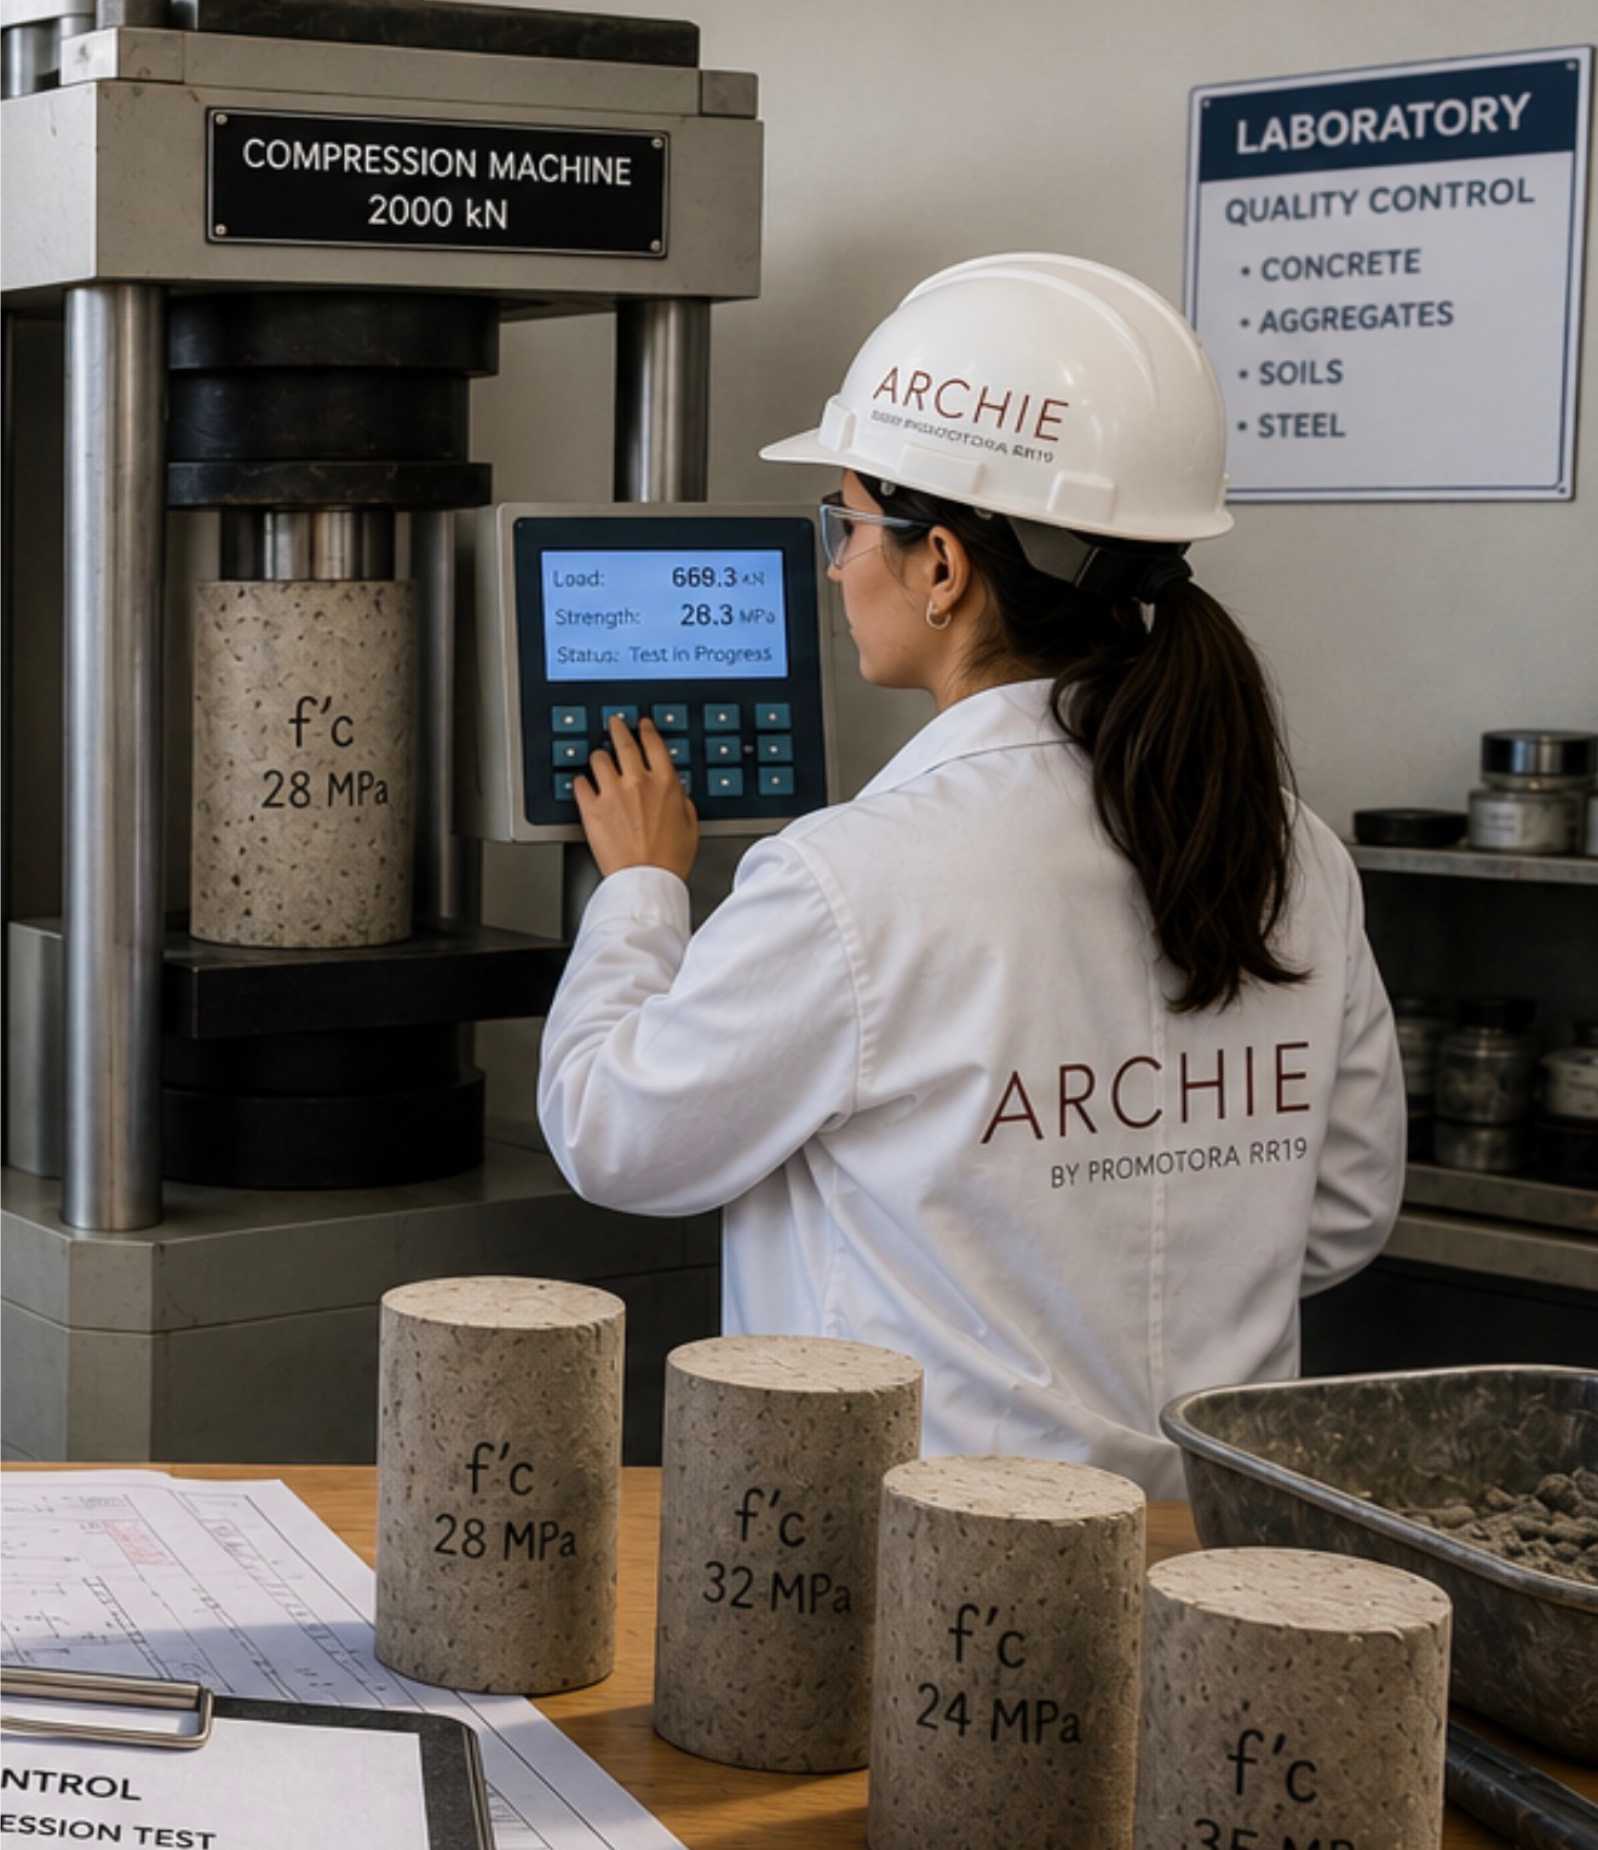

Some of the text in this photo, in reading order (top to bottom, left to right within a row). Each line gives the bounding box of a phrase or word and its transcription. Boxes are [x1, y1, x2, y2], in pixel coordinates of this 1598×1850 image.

[1236, 92, 1532, 155] LABORATORY
[242, 138, 632, 187] COMPRESSION MACHINE
[368, 195, 508, 230] 2000 kN
[1225, 178, 1535, 226] QUALITY CONTROL
[1261, 249, 1421, 282] CONCRETE
[1258, 301, 1454, 335] AGGREGATES
[1258, 359, 1343, 386] SOILS
[872, 366, 1069, 443] ARCHIE
[1257, 413, 1346, 439] STEEL
[553, 570, 604, 588] Load:
[555, 608, 640, 629] Strength:
[630, 646, 668, 662] Test
[672, 646, 690, 661] in
[694, 646, 772, 665] Progress
[261, 769, 388, 809] 28 MPa
[979, 1041, 1311, 1144] ARCHIE
[1050, 1137, 1308, 1189] BY PROMOTORA RR19
[434, 1513, 577, 1562] 28 MPa
[702, 1561, 851, 1615] 32 MPa
[915, 1682, 1082, 1745] 24 MPa
[0, 1768, 142, 1801] NTROL
[0, 1813, 217, 1850] ESSION TEST
